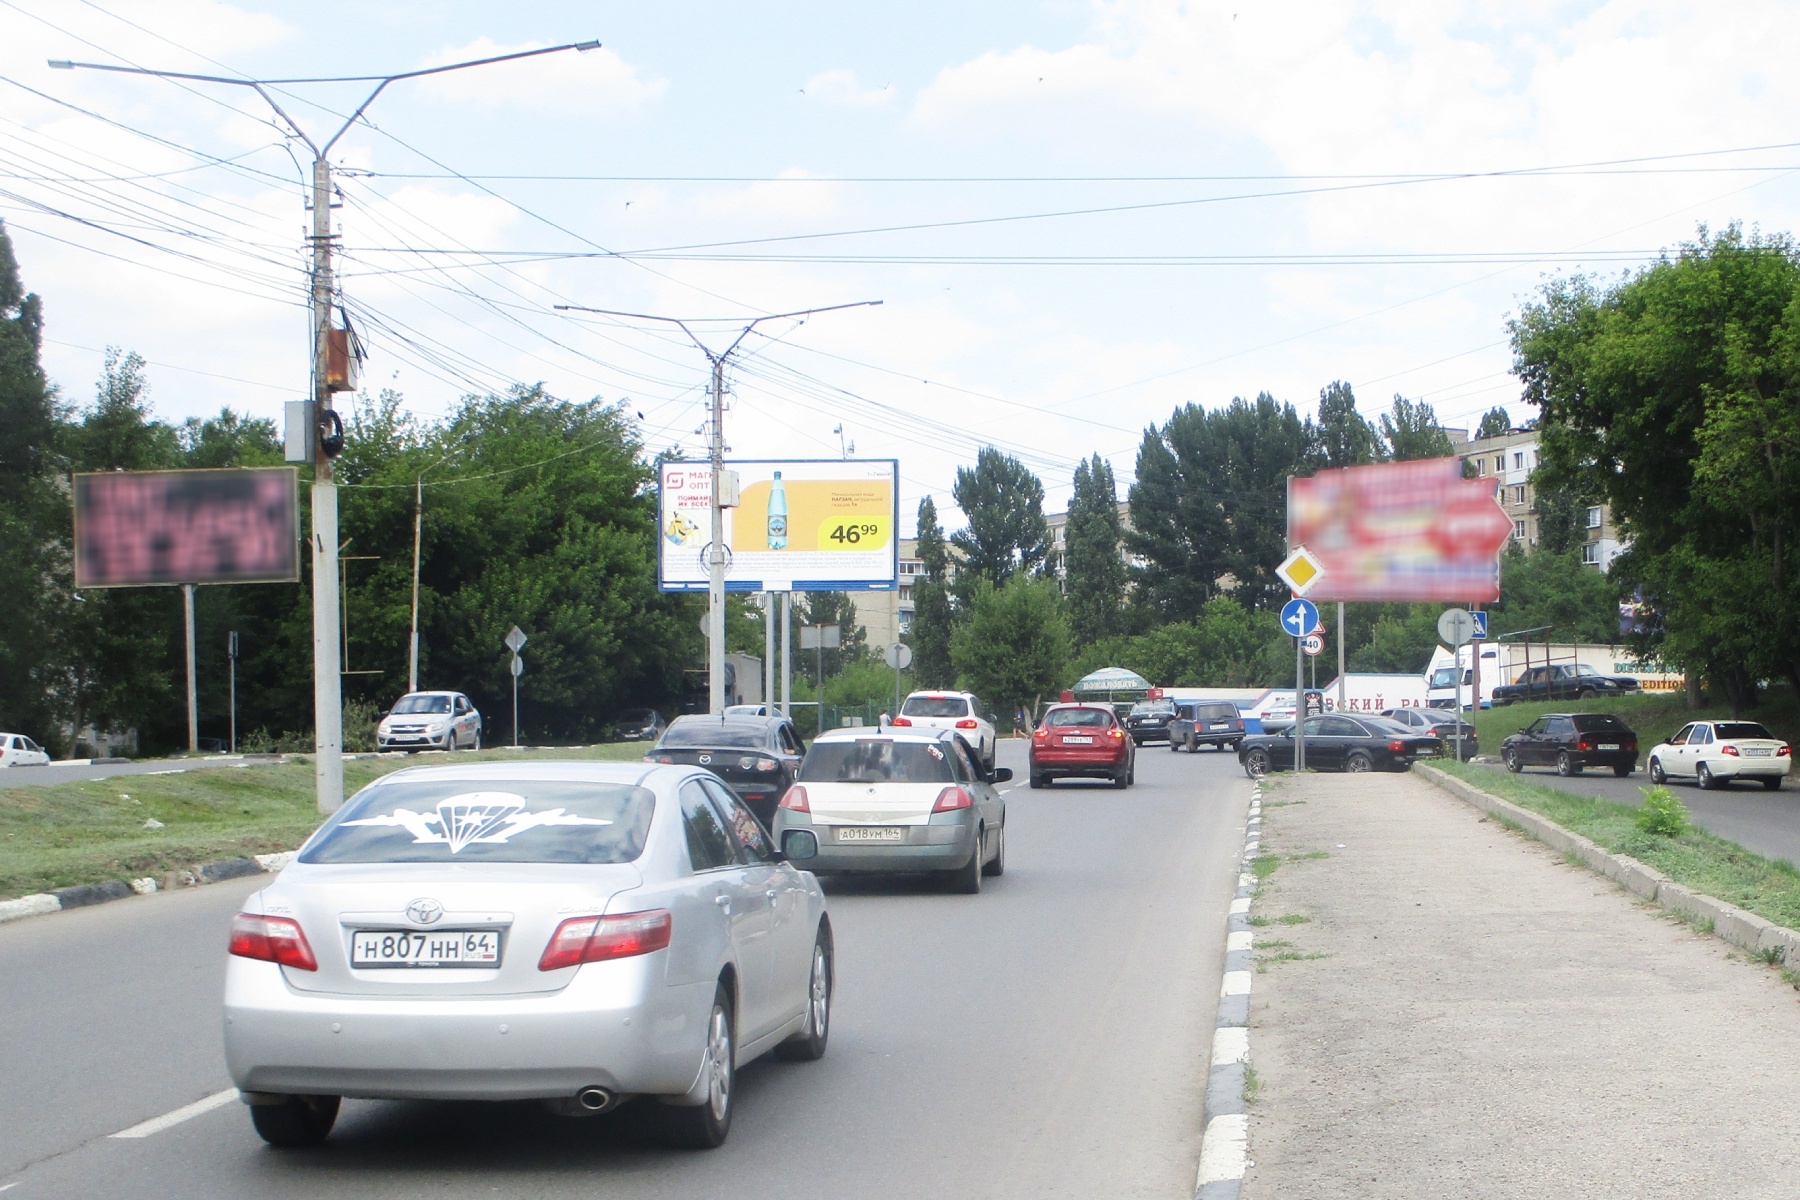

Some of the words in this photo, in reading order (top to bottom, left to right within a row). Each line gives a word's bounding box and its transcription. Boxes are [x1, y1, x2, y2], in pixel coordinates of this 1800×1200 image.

[689, 471, 714, 479] МАГН
[689, 482, 710, 490] ОПТ
[830, 524, 861, 544] 46
[1306, 640, 1319, 649] 40
[842, 828, 882, 839] А018УМ
[884, 828, 900, 837] 164
[364, 935, 459, 958] Н807НН
[465, 934, 488, 952] 64
